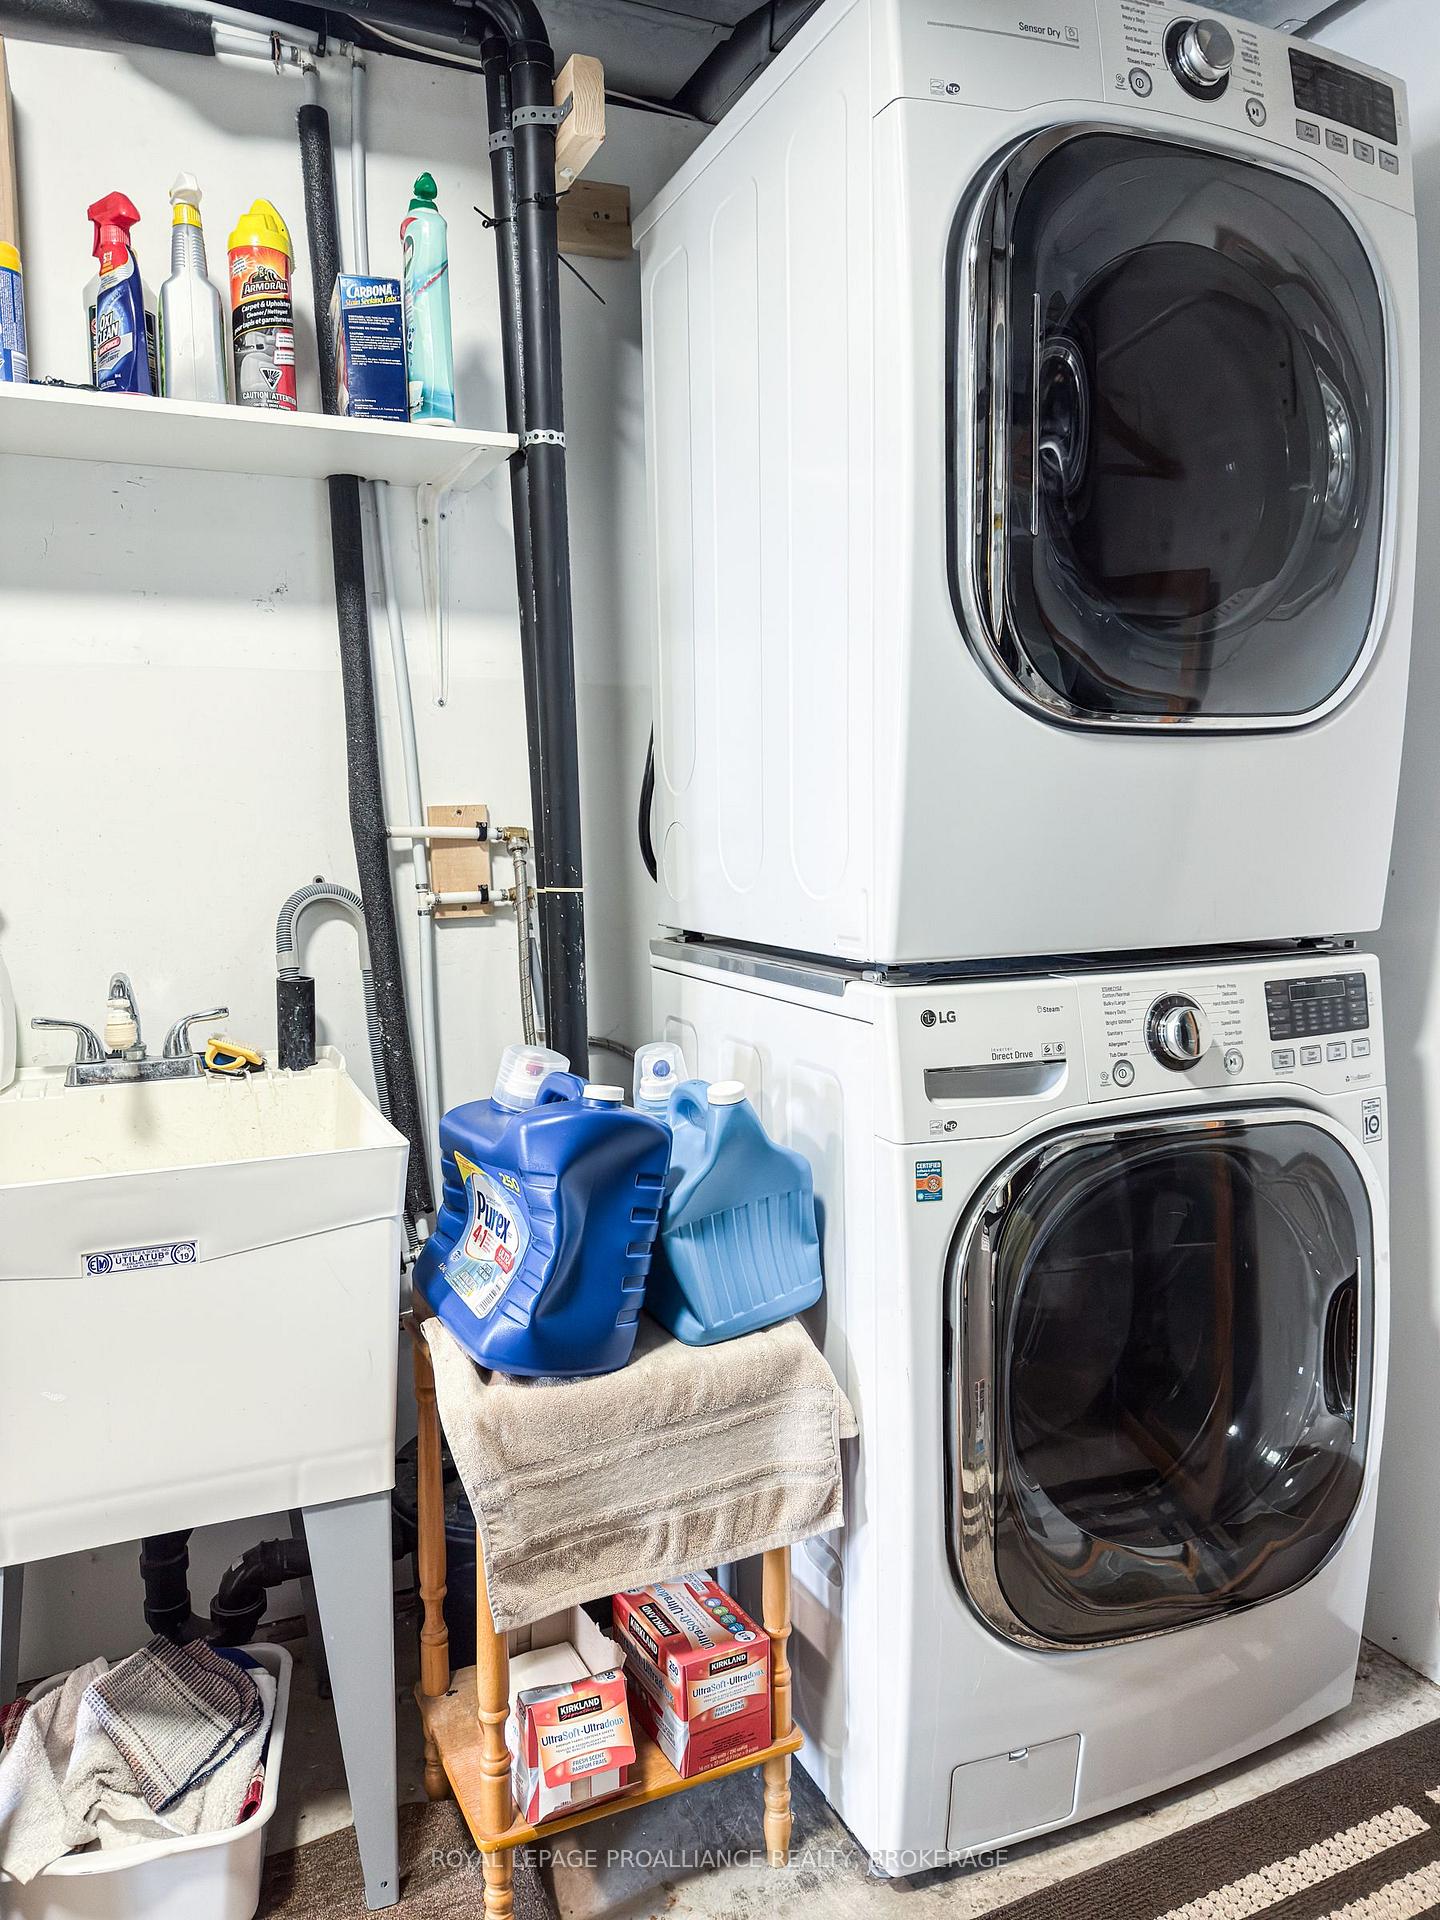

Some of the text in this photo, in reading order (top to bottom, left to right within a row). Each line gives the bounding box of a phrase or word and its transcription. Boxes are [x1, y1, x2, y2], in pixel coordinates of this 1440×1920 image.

[1018, 21, 1061, 39] Sensor Dry
[346, 283, 393, 299] CARBONA
[241, 302, 260, 313] Carpet
[242, 391, 269, 400] CAUTION
[938, 1010, 957, 1024] LG
[991, 1050, 1033, 1061] Direct Drive
[1364, 1114, 1380, 1135] 10
[476, 1190, 511, 1244] Purex
[180, 1253, 190, 1261] 19
[641, 1605, 673, 1636] KIRKLAND
[629, 1616, 658, 1655] KIRKLAND
[711, 1653, 747, 1671] KIRKLAND
[559, 1697, 600, 1715] KIRKLAND
[572, 1752, 605, 1767] FRESH SCENT
[572, 1757, 608, 1773] PARFUM FRAIS
